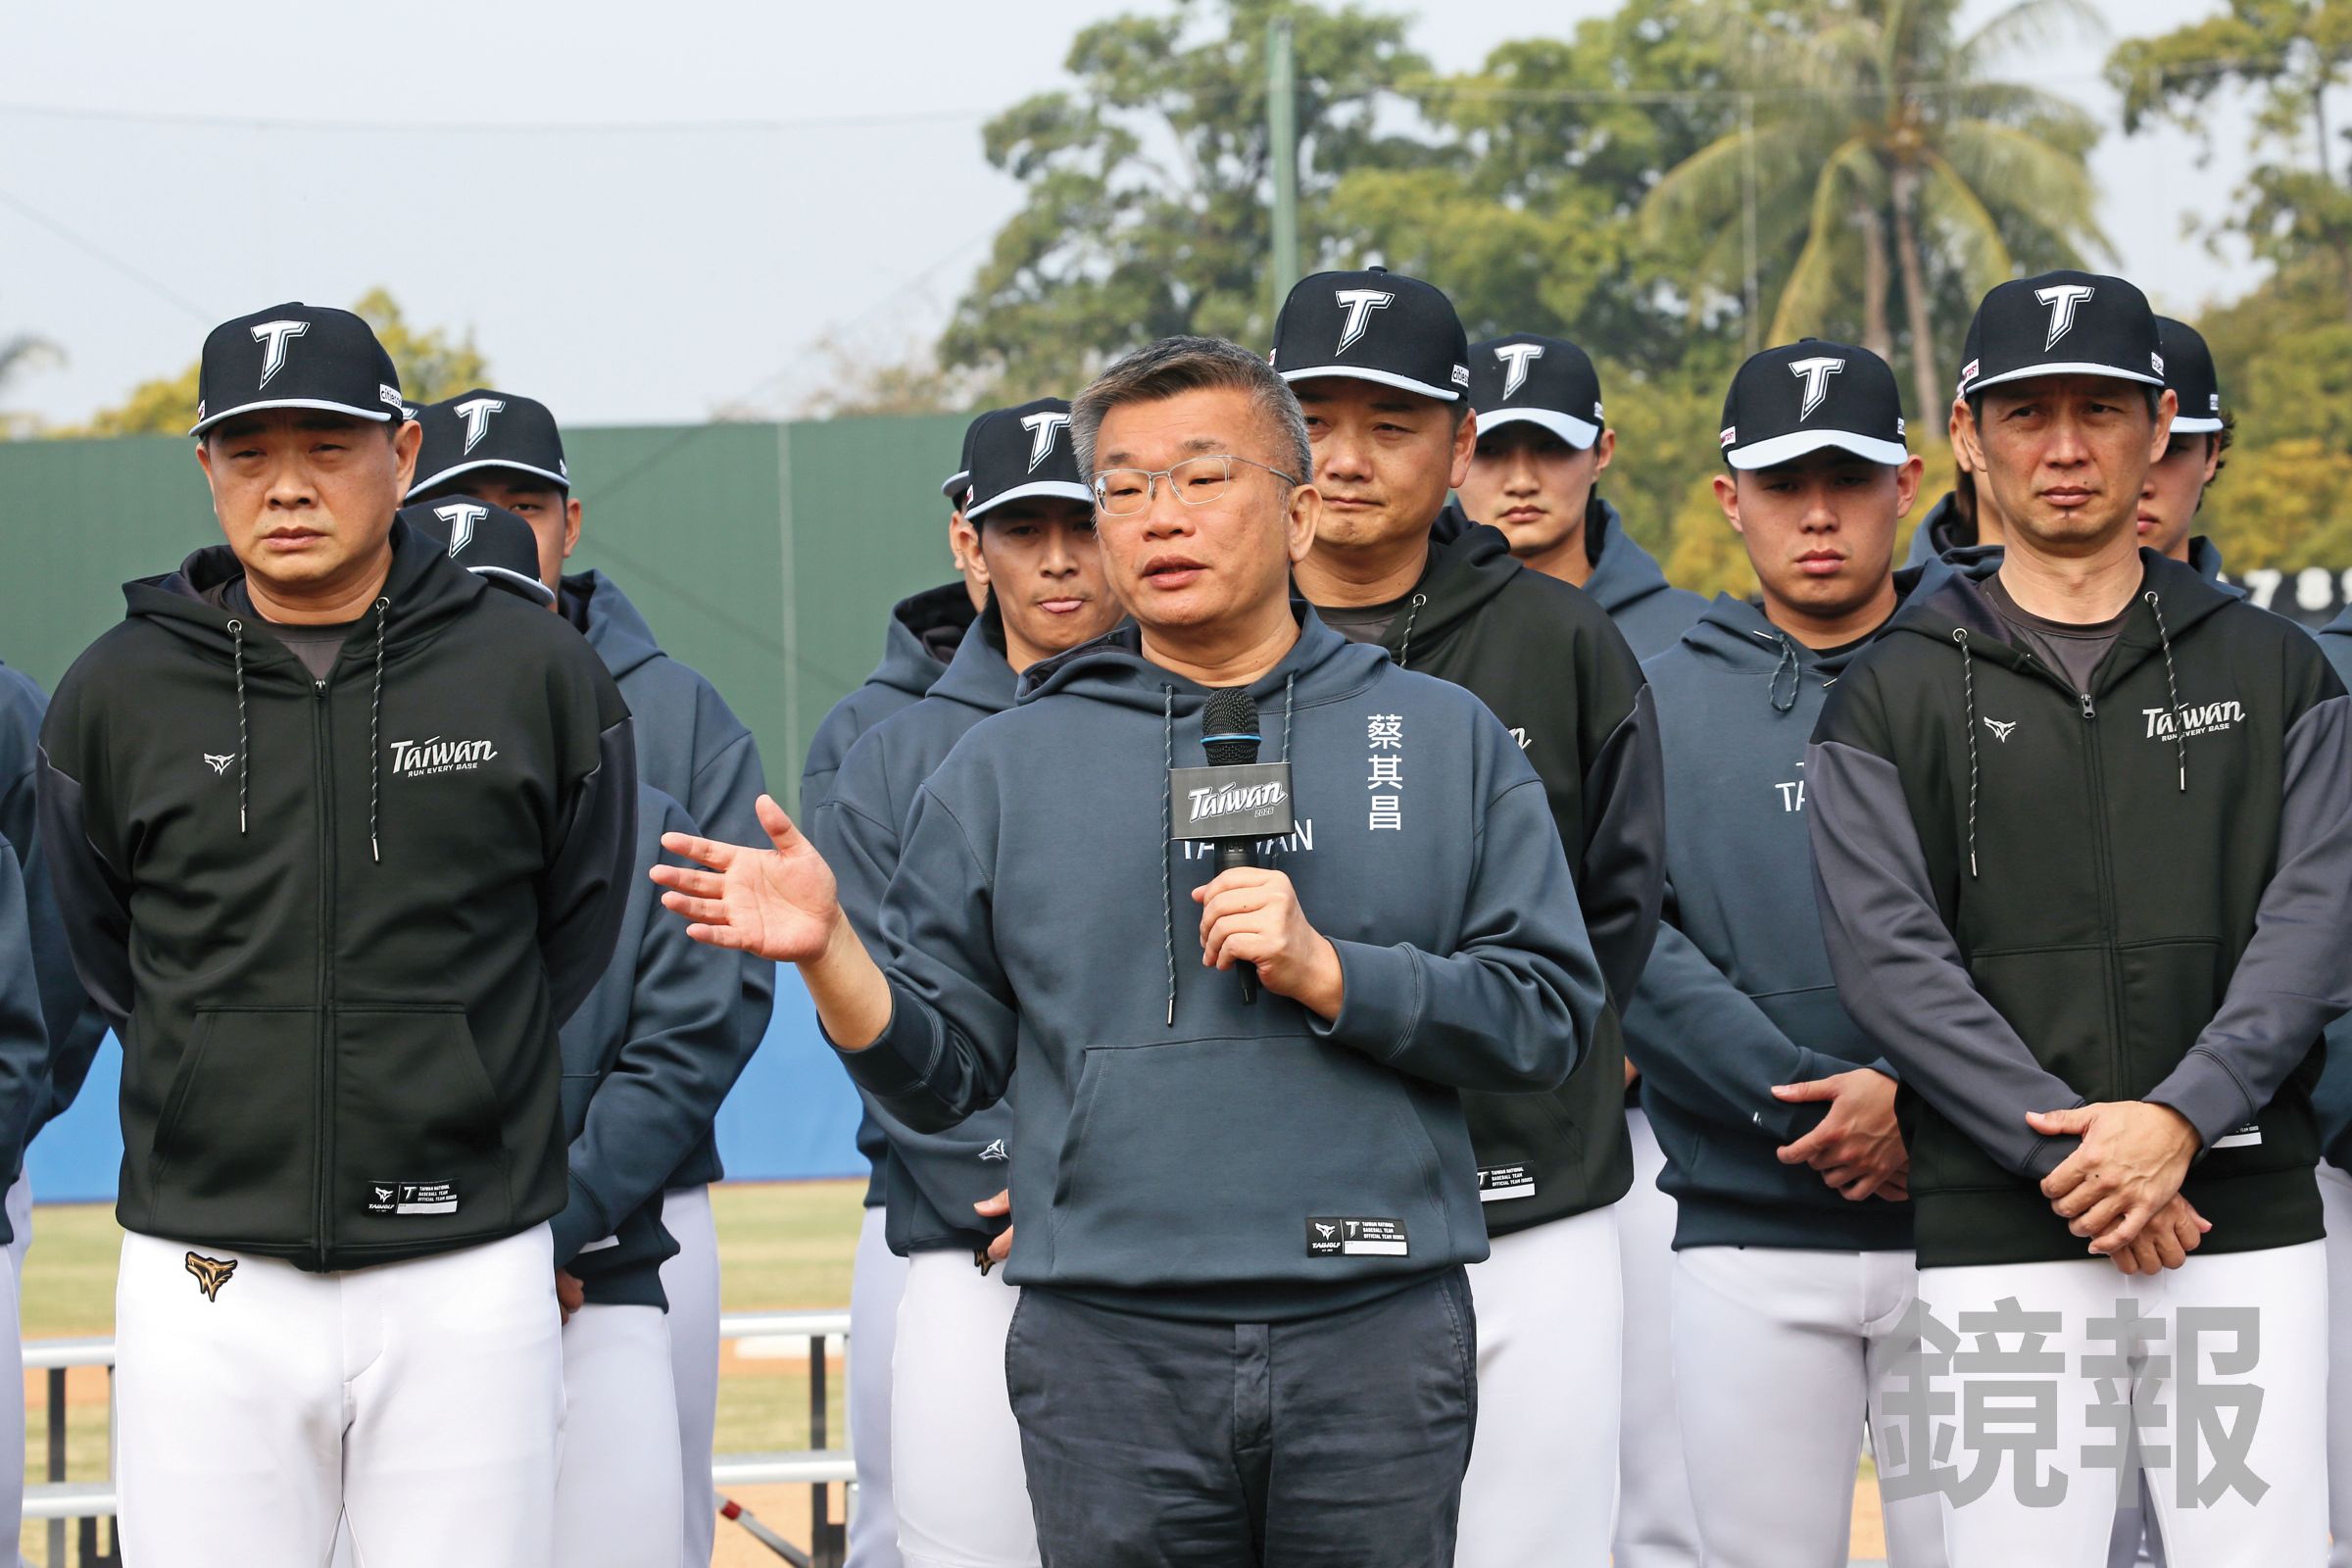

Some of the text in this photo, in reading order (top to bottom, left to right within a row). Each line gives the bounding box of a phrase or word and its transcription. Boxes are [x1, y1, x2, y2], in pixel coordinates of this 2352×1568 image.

[1336, 289, 1395, 357] T
[2034, 285, 2094, 352] T
[251, 319, 310, 390] T
[1494, 343, 1544, 400] T
[1788, 357, 1845, 422] T
[454, 399, 506, 456] T
[1020, 412, 1071, 474] T
[433, 504, 489, 558] T
[2162, 722, 2230, 742] RUN VERY BASE
[408, 769, 424, 778] RUN
[427, 764, 454, 774] EVERY
[1367, 713, 1403, 831] 蔡其昌
